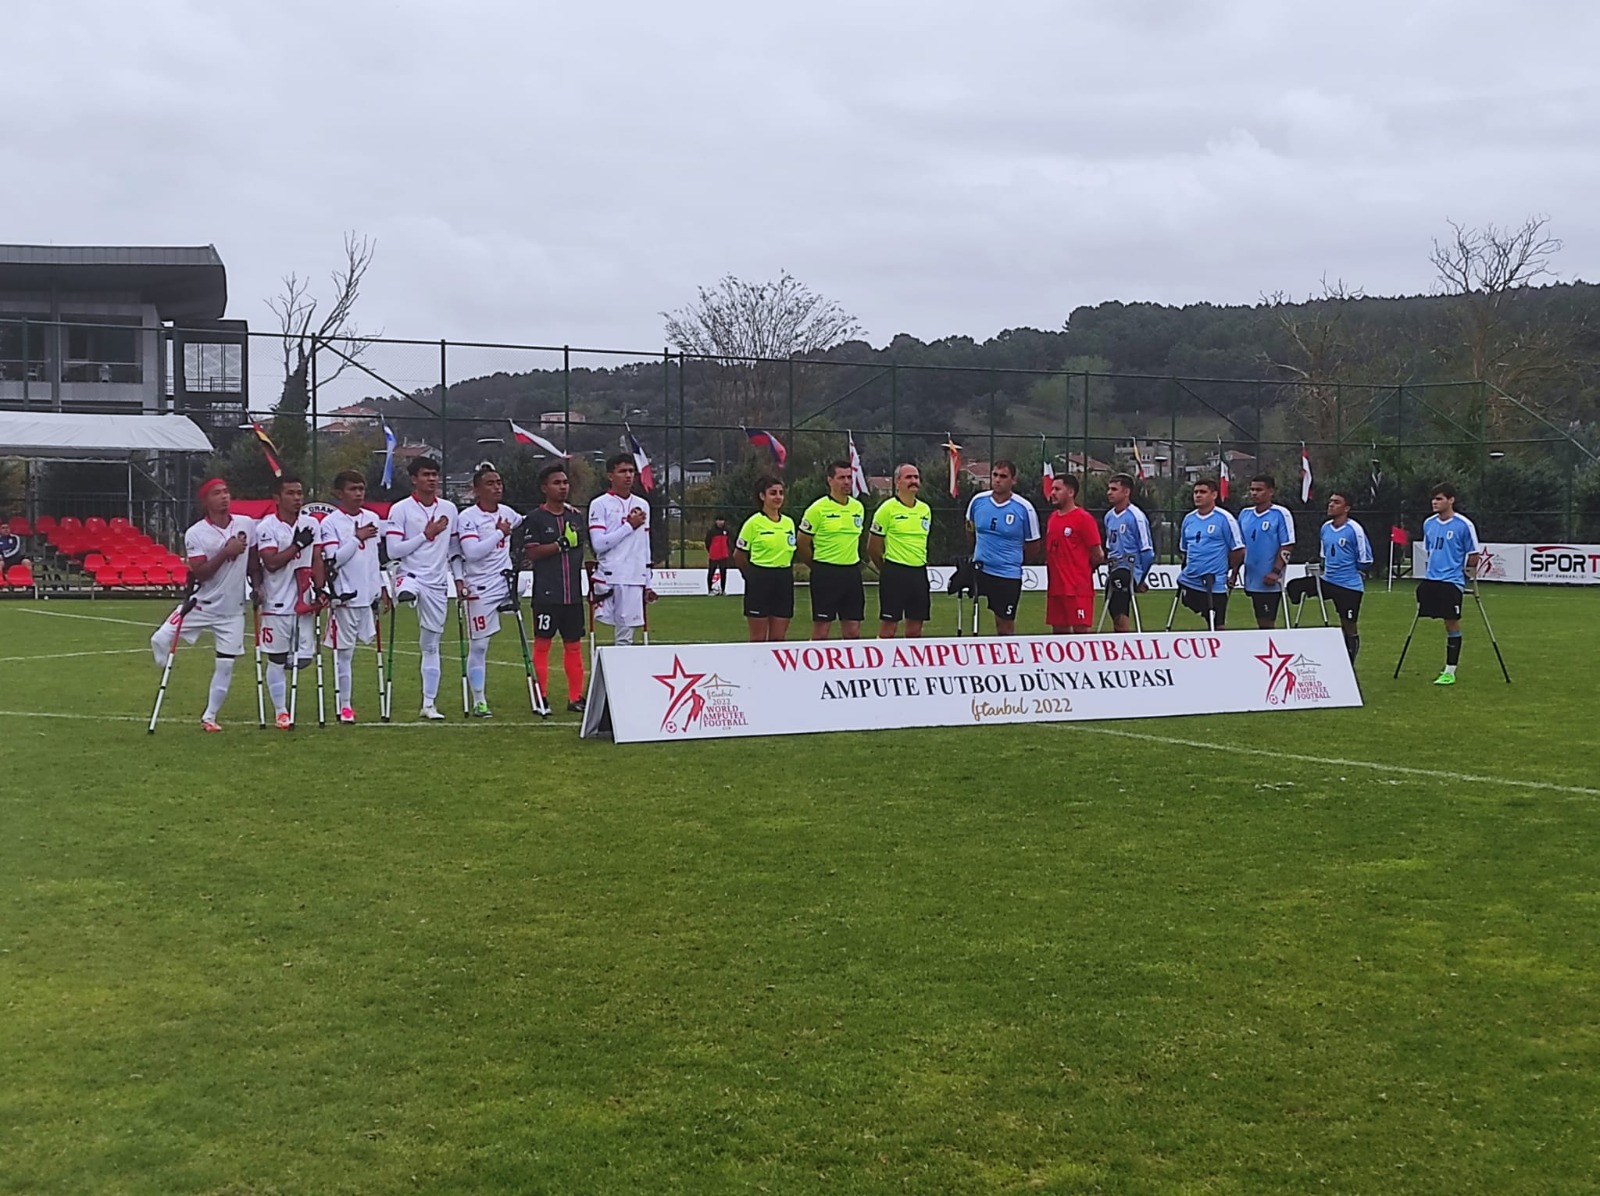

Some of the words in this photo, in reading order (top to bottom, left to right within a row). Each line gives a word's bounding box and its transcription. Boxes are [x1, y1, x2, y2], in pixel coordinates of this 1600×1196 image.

[473, 615, 488, 632] 19
[537, 614, 551, 631] 13
[262, 627, 273, 644] 15
[771, 645, 884, 672] WORLD
[892, 642, 1025, 668] AMPUTEE
[1029, 639, 1170, 663] FOOTBALL
[1173, 637, 1221, 659] CUP
[820, 677, 920, 700] AMPUTE
[925, 674, 1016, 696] FUTBOL
[1019, 668, 1095, 692] DÜNYA
[1098, 669, 1175, 689] KUPASI
[1298, 680, 1323, 688] WORLD
[706, 705, 739, 714] WORLD
[1032, 697, 1073, 714] 2022
[703, 712, 745, 720] AMPUTEE
[703, 718, 749, 727] FOOTBALL
